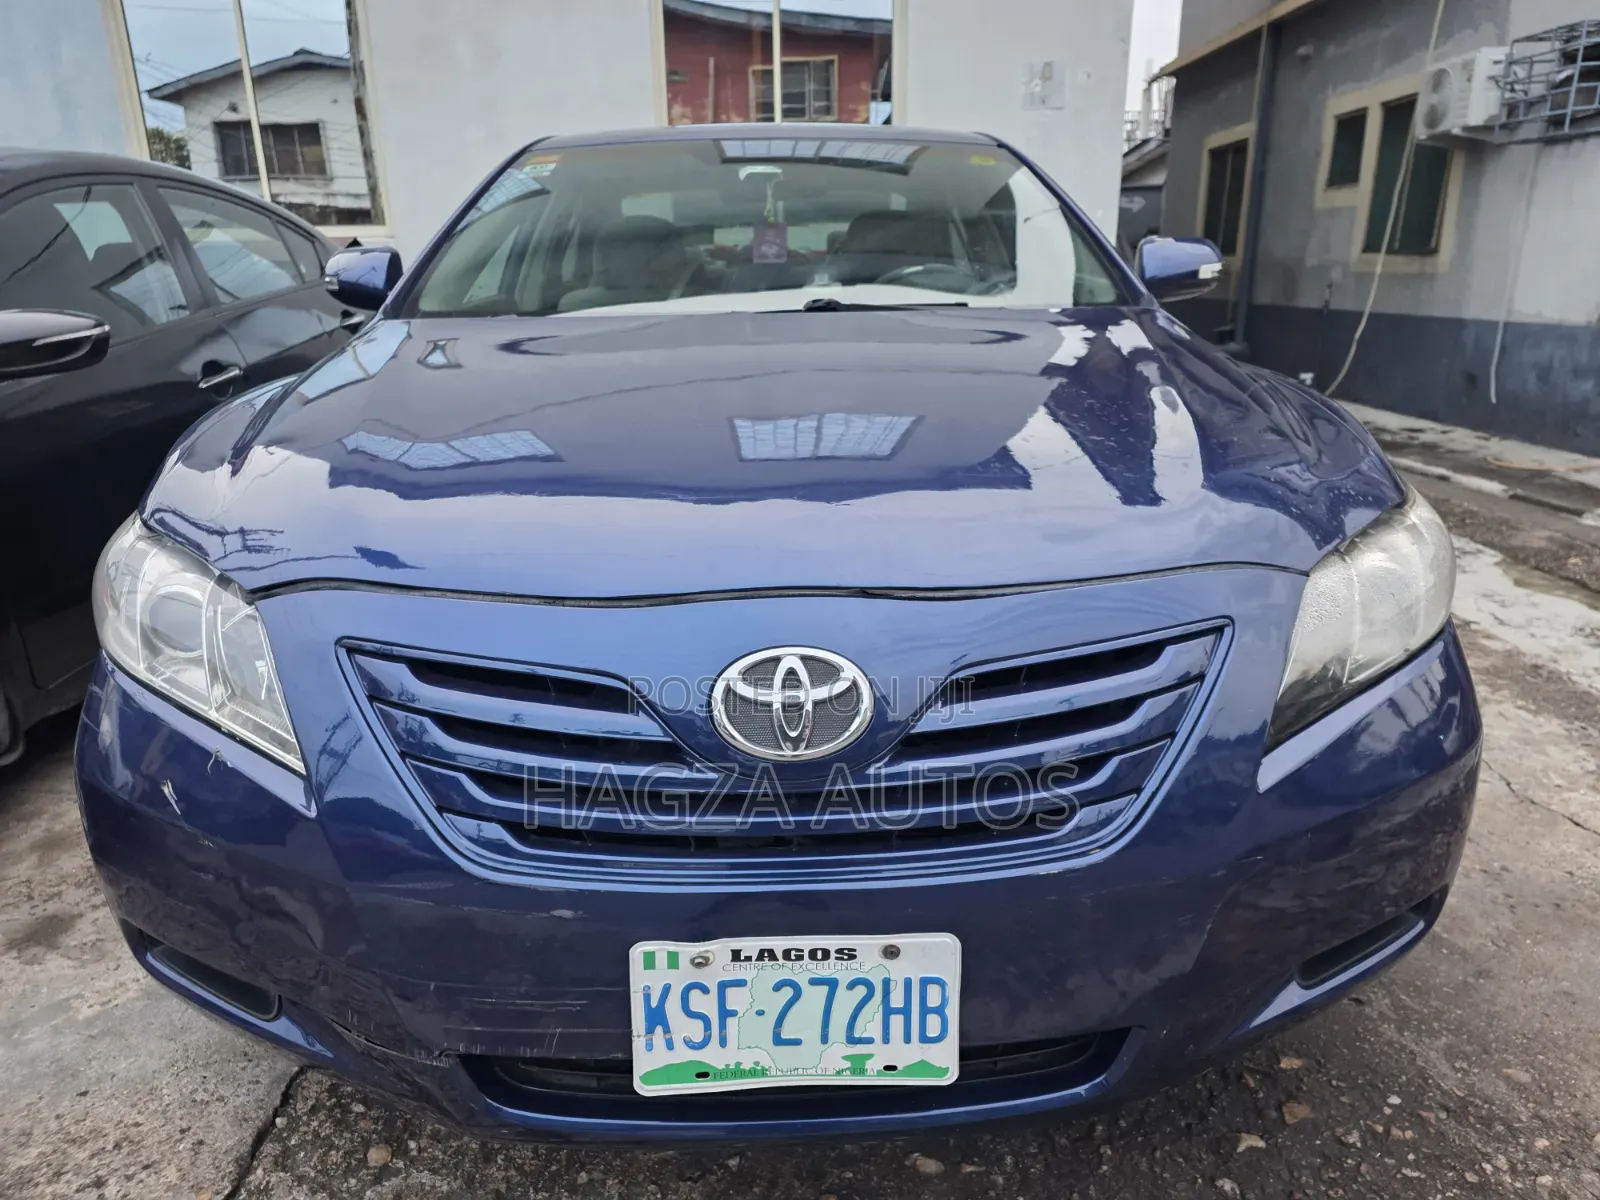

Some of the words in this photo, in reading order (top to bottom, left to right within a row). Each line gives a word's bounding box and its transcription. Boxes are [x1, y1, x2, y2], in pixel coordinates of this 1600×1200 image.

[730, 947, 857, 963] LAGOS
[722, 962, 767, 972] CENTRE
[771, 962, 787, 971] OF
[791, 961, 866, 971] EXCELLENCE
[713, 1069, 760, 1080] FEDERAL
[762, 1066, 813, 1076] REPUBLIC
[815, 1066, 830, 1075] OF
[833, 1067, 876, 1076] NIGERIA
